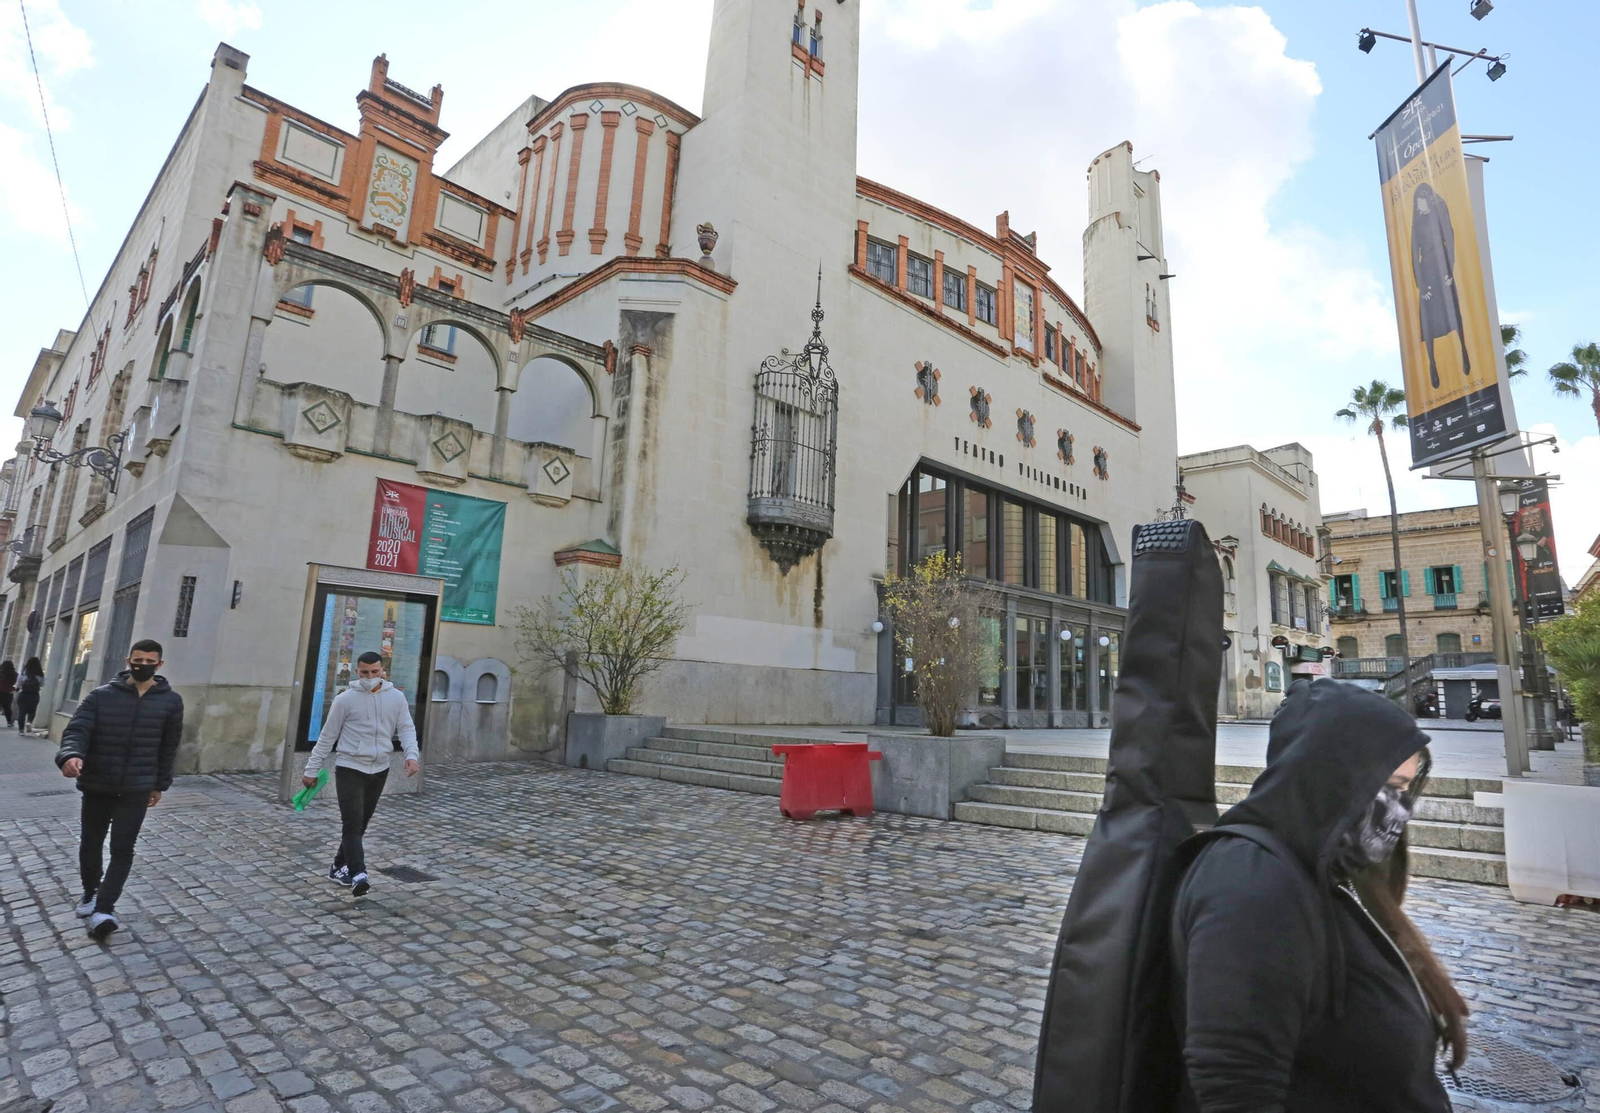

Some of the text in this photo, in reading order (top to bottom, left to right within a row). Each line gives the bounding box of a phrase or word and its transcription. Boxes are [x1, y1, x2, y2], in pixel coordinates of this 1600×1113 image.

[954, 436, 1087, 500] TEATRO VILLAMARTA
[381, 506, 408, 517] TEMPORADA
[378, 525, 416, 543] MUSICAL
[376, 539, 401, 554] 2020
[374, 552, 398, 568] 2021
[1532, 566, 1554, 575] ovador
